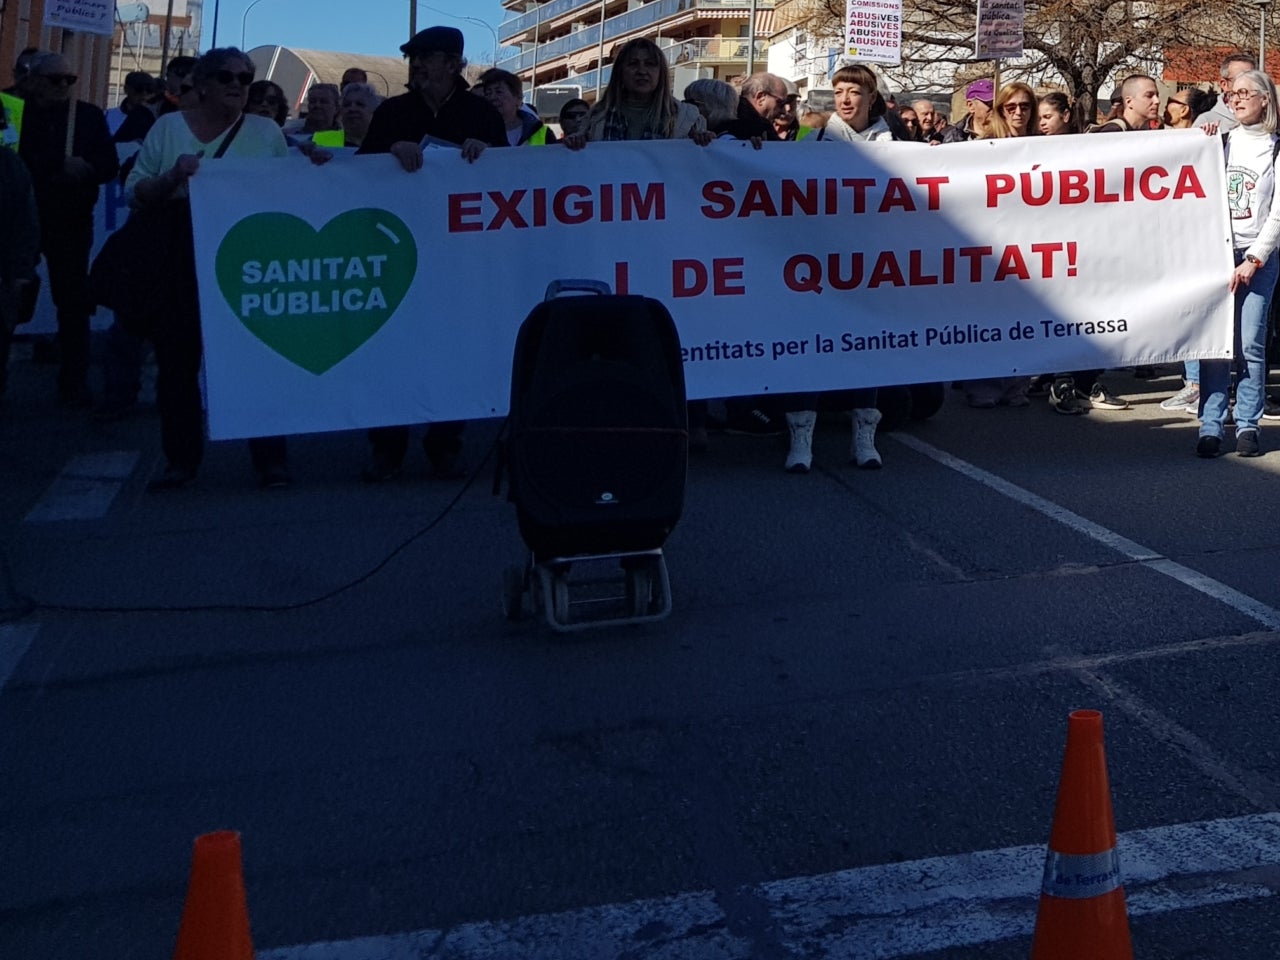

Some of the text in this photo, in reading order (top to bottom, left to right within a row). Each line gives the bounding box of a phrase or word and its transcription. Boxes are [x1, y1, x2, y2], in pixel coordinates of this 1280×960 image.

[448, 164, 1208, 233] EXIGIM SANITAT PÚBLICA
[242, 254, 388, 284] SANITAT
[615, 241, 1079, 298] I DE QUALITAT!
[241, 287, 388, 317] PÚBLICA
[772, 340, 809, 361] per
[815, 334, 835, 354] la
[841, 330, 919, 353] Sanitat
[926, 323, 1002, 347] Pública
[1008, 321, 1035, 340] de
[1040, 319, 1128, 338] Terrassa
